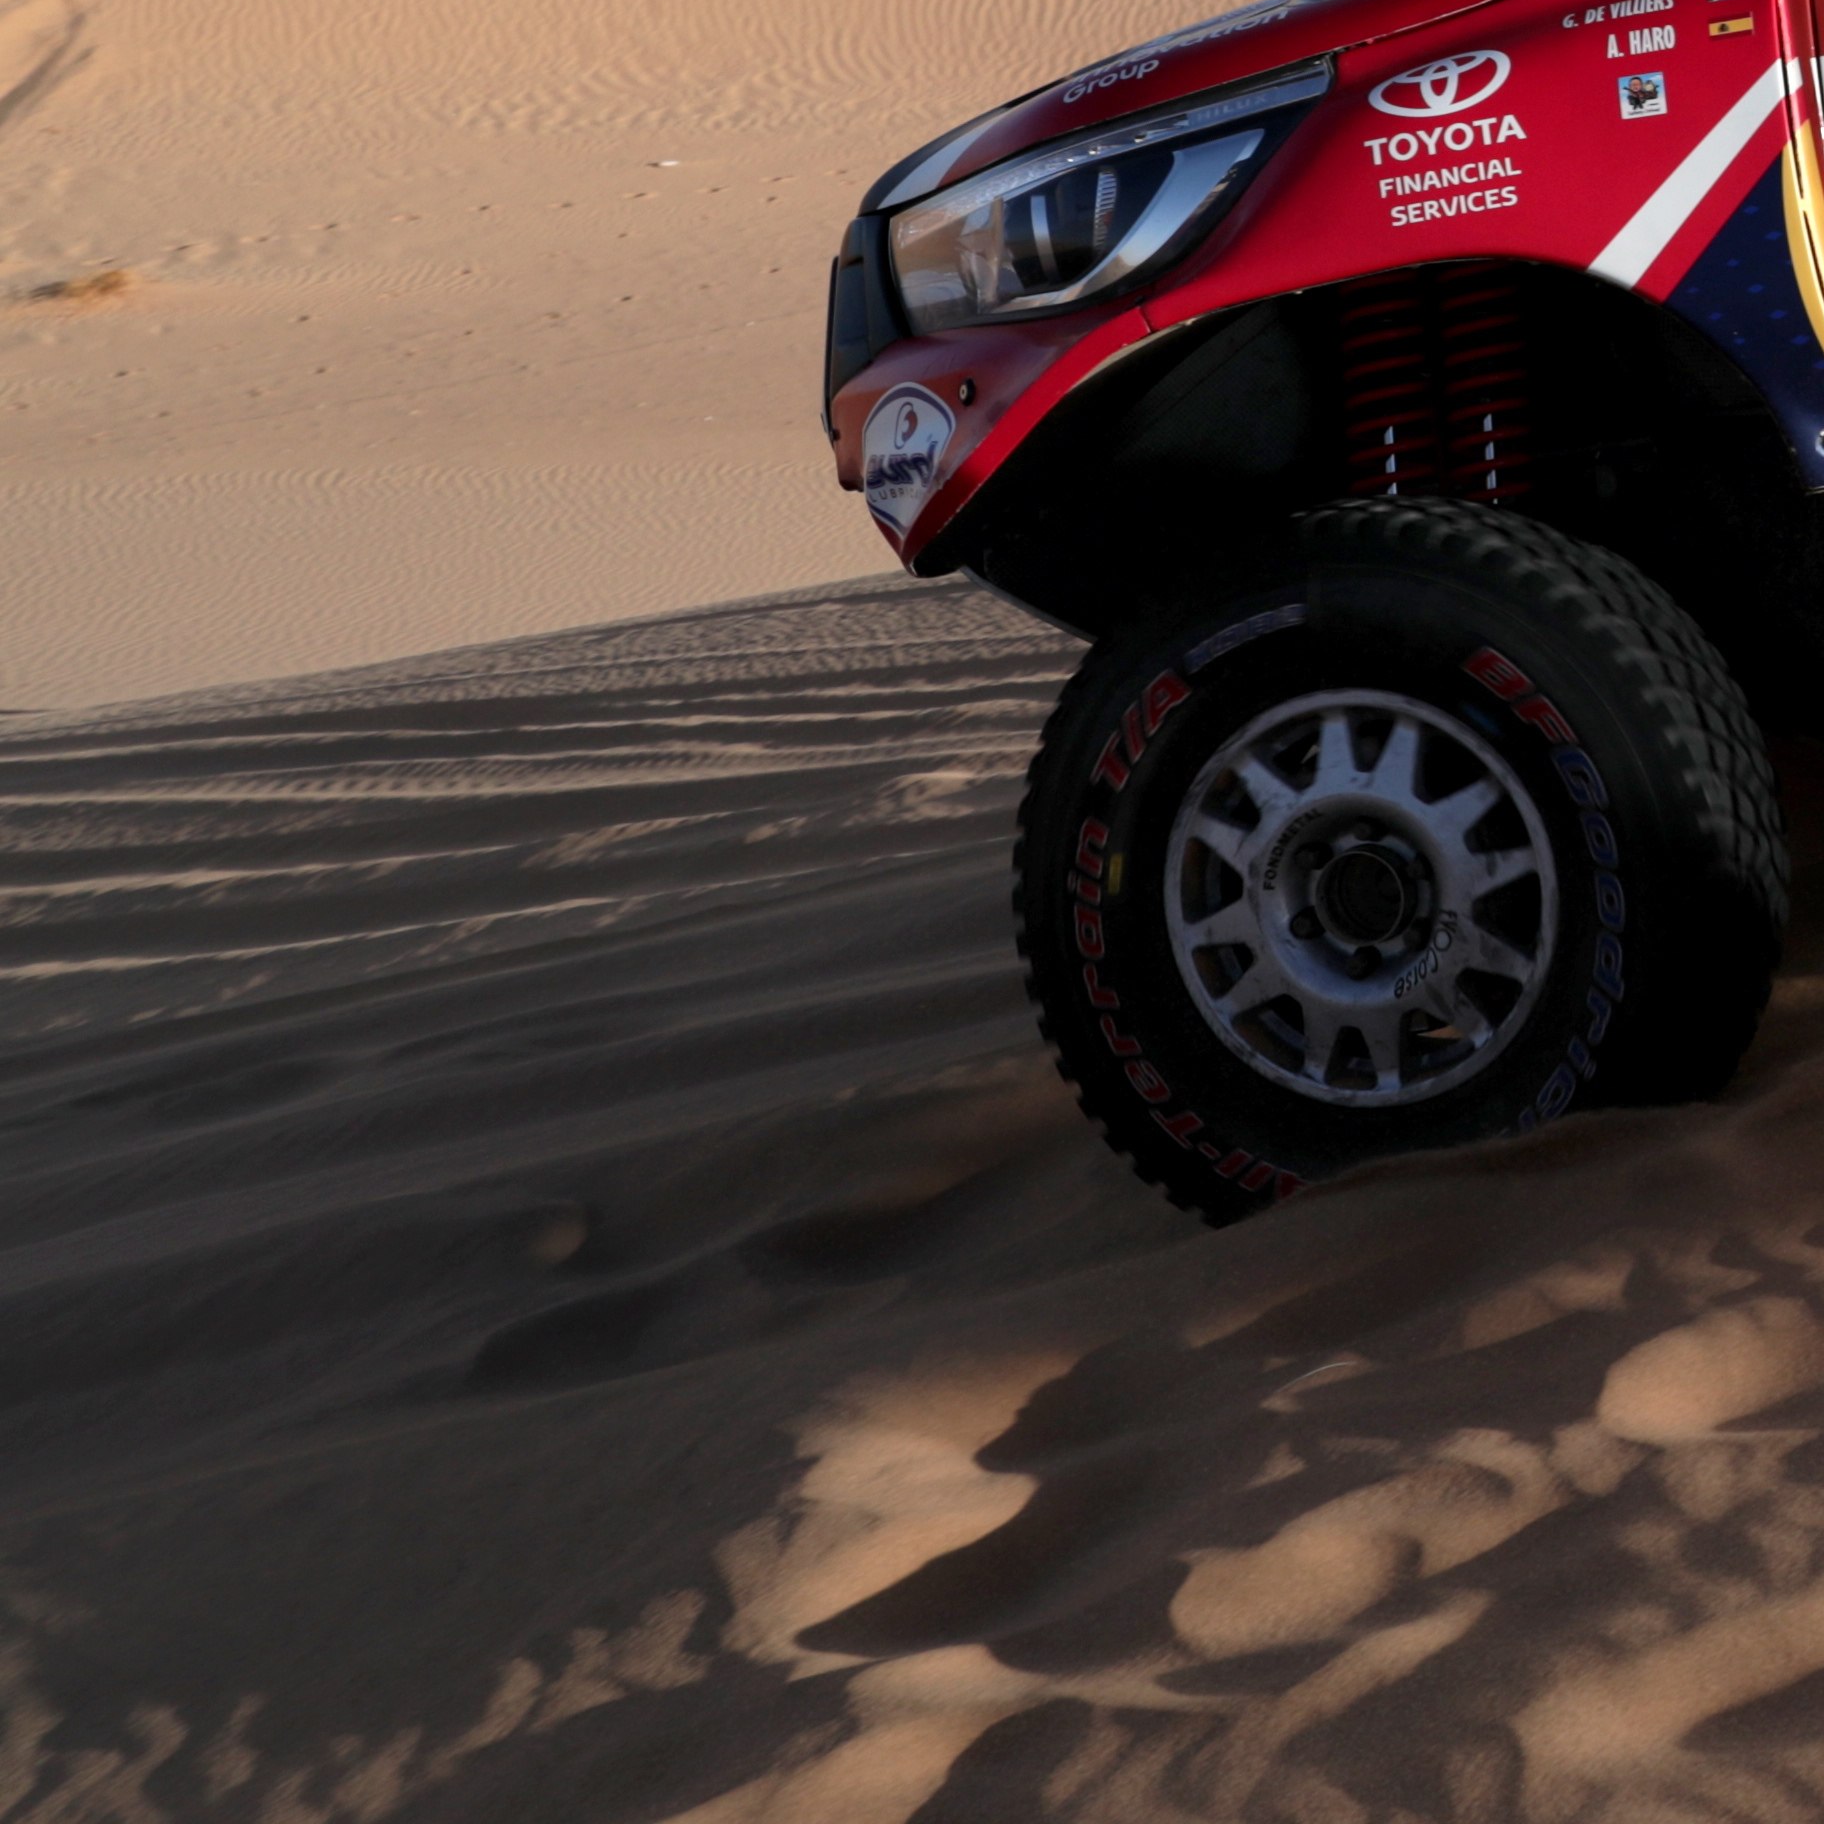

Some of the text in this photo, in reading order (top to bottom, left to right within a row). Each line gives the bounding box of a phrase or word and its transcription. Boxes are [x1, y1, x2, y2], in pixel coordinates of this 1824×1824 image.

[1562, 13, 1579, 29] G.
[1584, 5, 1605, 25] DE
[1607, 25, 1676, 59] A. HARO
[1062, 59, 1160, 104] Group
[1363, 114, 1527, 166] TOYOTA
[1379, 157, 1522, 199] FINANCIAL
[1390, 186, 1519, 227] SERVICES
[1263, 808, 1324, 891] FONDMETAL
